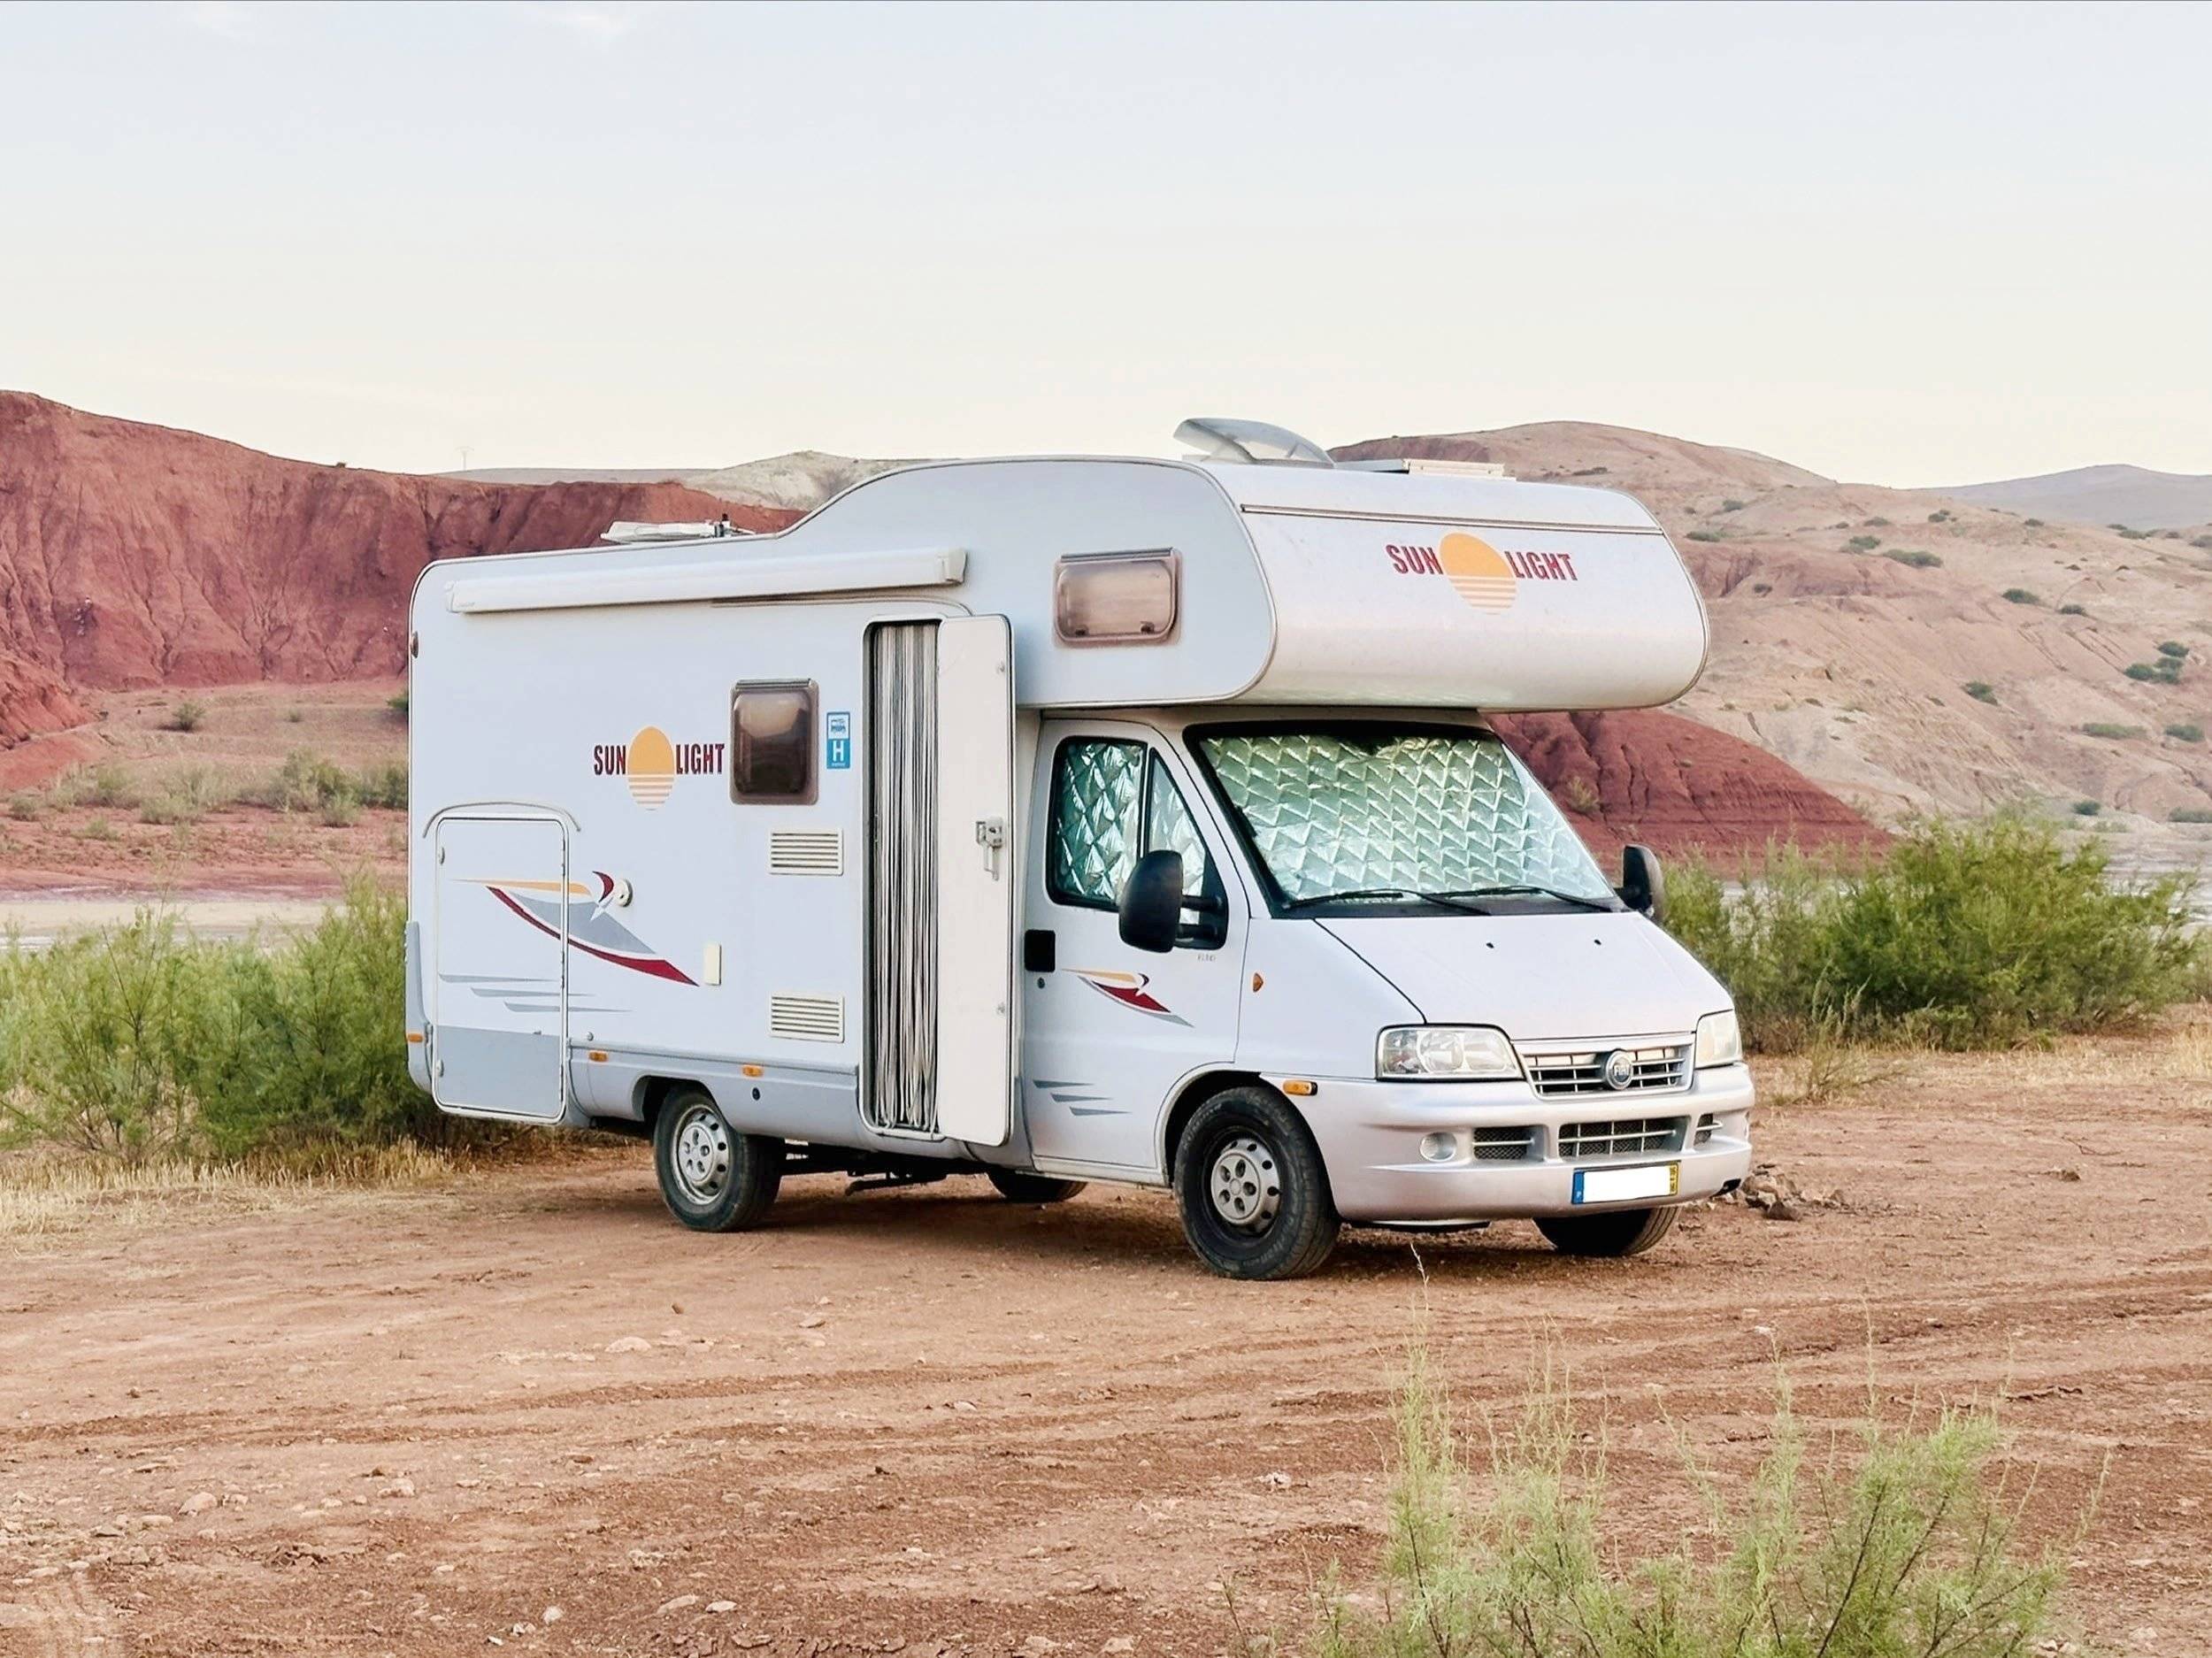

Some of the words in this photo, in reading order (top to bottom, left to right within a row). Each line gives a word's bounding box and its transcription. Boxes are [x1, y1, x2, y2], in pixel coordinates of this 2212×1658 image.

[1386, 544, 1443, 575] SUN
[1504, 550, 1578, 581] LIGHT
[593, 744, 626, 776] SUN
[676, 743, 725, 776] LIGHT
[832, 740, 844, 762] H
